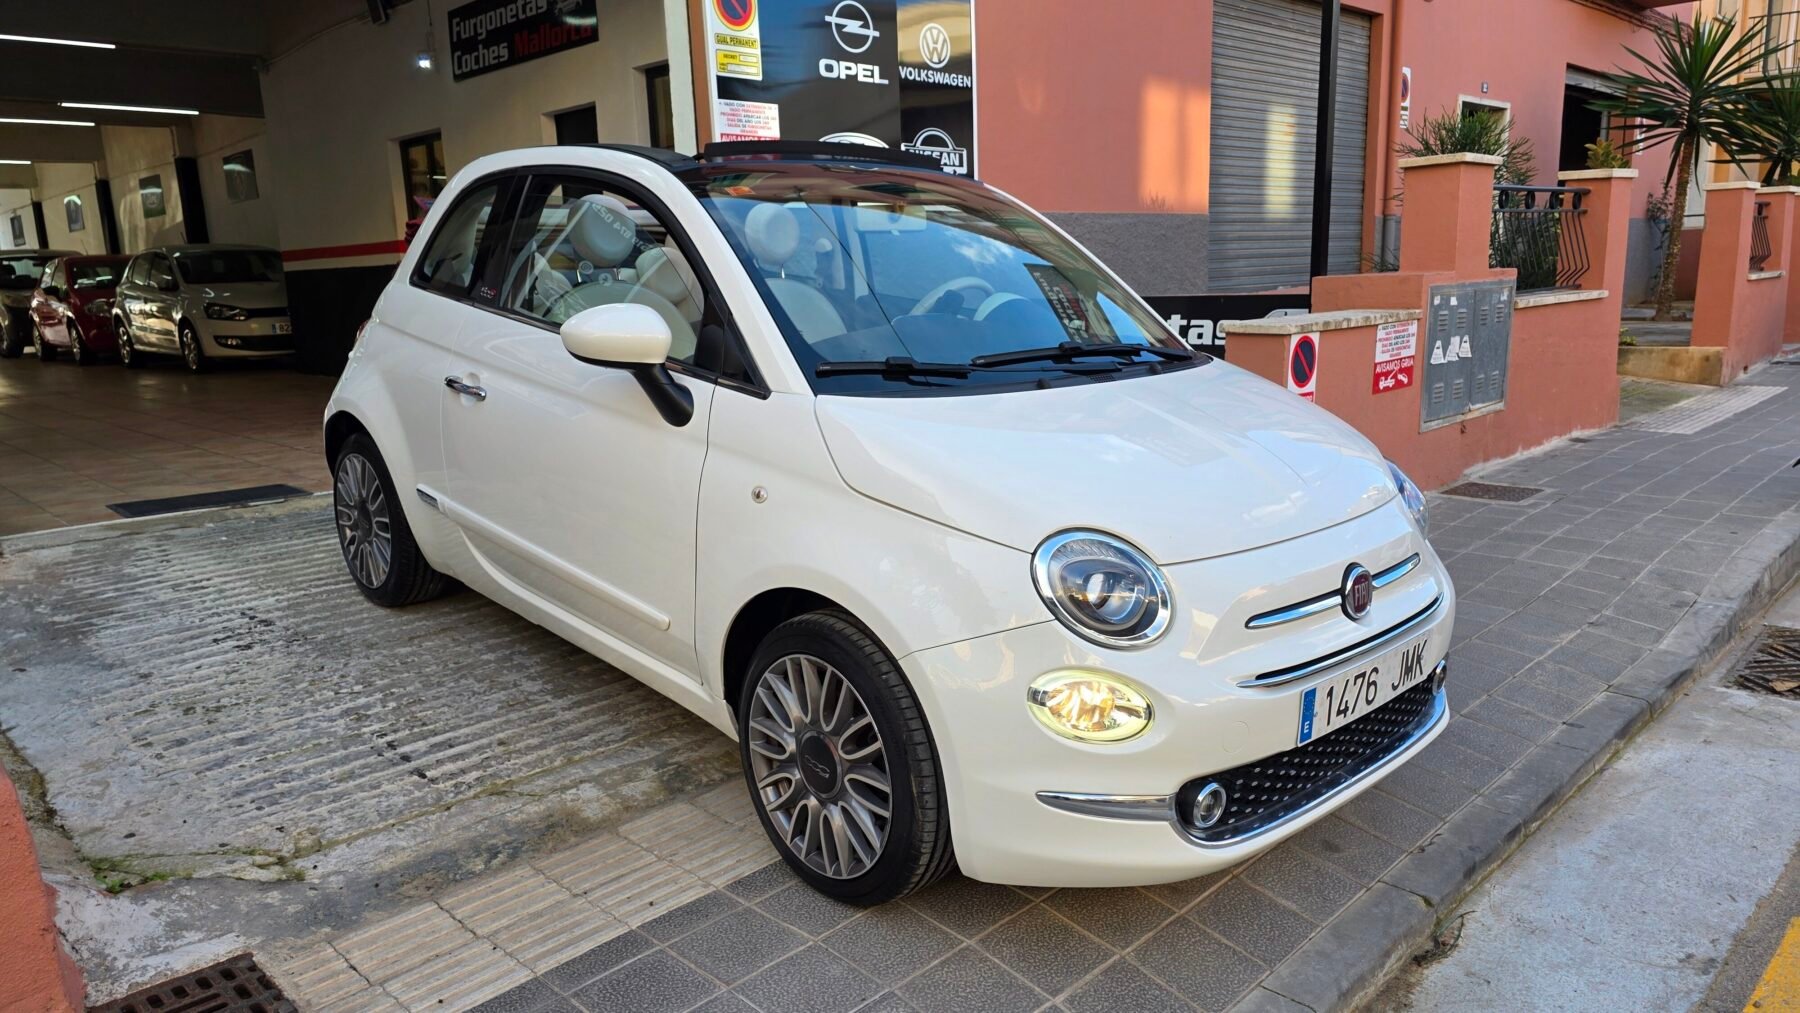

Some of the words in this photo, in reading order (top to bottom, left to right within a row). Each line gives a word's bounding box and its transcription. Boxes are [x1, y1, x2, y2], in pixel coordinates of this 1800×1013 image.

[452, 0, 548, 42] Furgonetas
[453, 42, 509, 75] Coches
[818, 58, 889, 85] OPEL
[899, 66, 971, 88] VOLKSWAGEN
[1375, 360, 1400, 373] AVISAMOS
[1401, 357, 1414, 369] GRUA
[1354, 581, 1370, 606] FIAT
[1326, 666, 1380, 727] 1476
[1391, 639, 1428, 692] JMK
[1303, 721, 1310, 733] E
